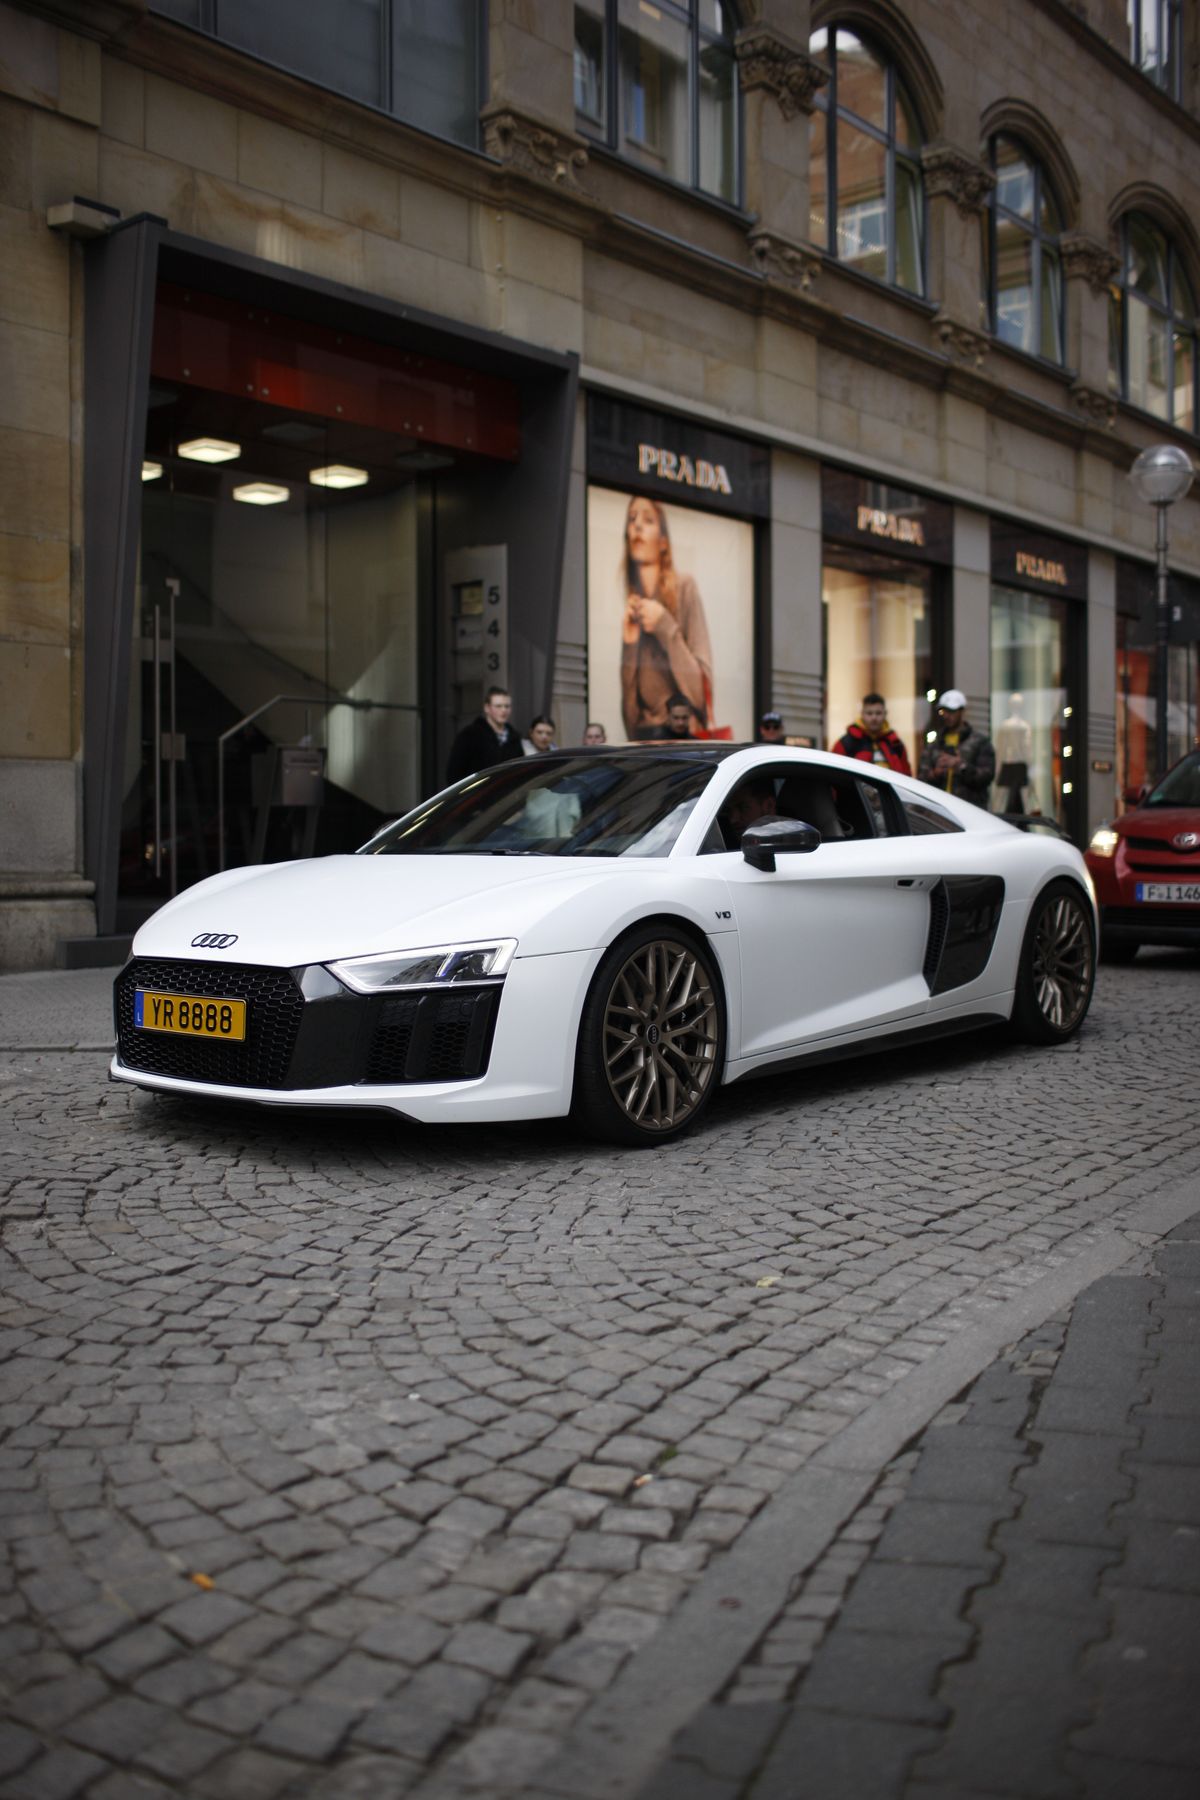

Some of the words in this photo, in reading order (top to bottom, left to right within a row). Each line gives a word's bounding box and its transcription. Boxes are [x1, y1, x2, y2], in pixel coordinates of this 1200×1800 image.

[638, 443, 732, 494] PRADA
[857, 505, 926, 547] PRADA
[488, 586, 500, 605] 5
[488, 620, 500, 637] 4
[488, 652, 500, 671] 3
[715, 911, 732, 919] V10
[152, 997, 174, 1027] YR
[179, 1001, 233, 1034] 8888
